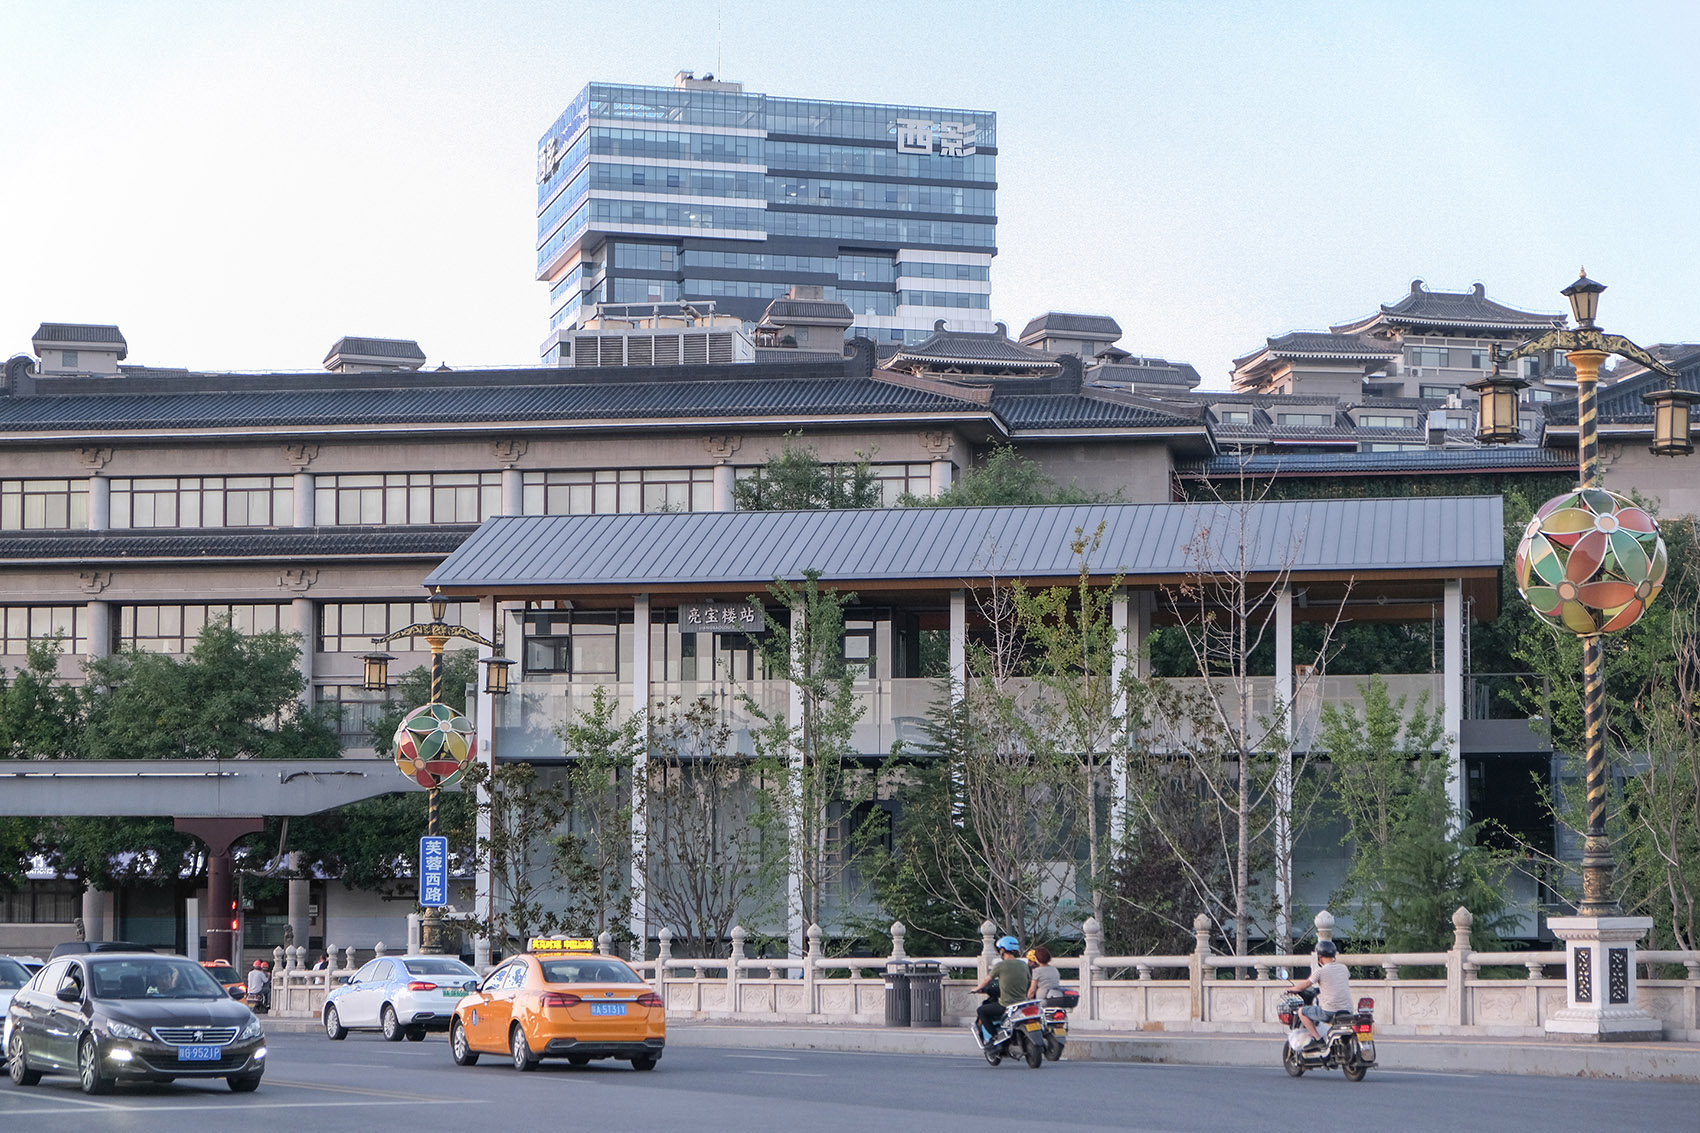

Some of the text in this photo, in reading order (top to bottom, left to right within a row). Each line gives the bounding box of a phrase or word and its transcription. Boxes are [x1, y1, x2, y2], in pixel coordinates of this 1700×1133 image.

[896, 118, 977, 157] 西影
[688, 606, 755, 625] 亮宝楼站
[425, 840, 442, 902] 芙蓉西路
